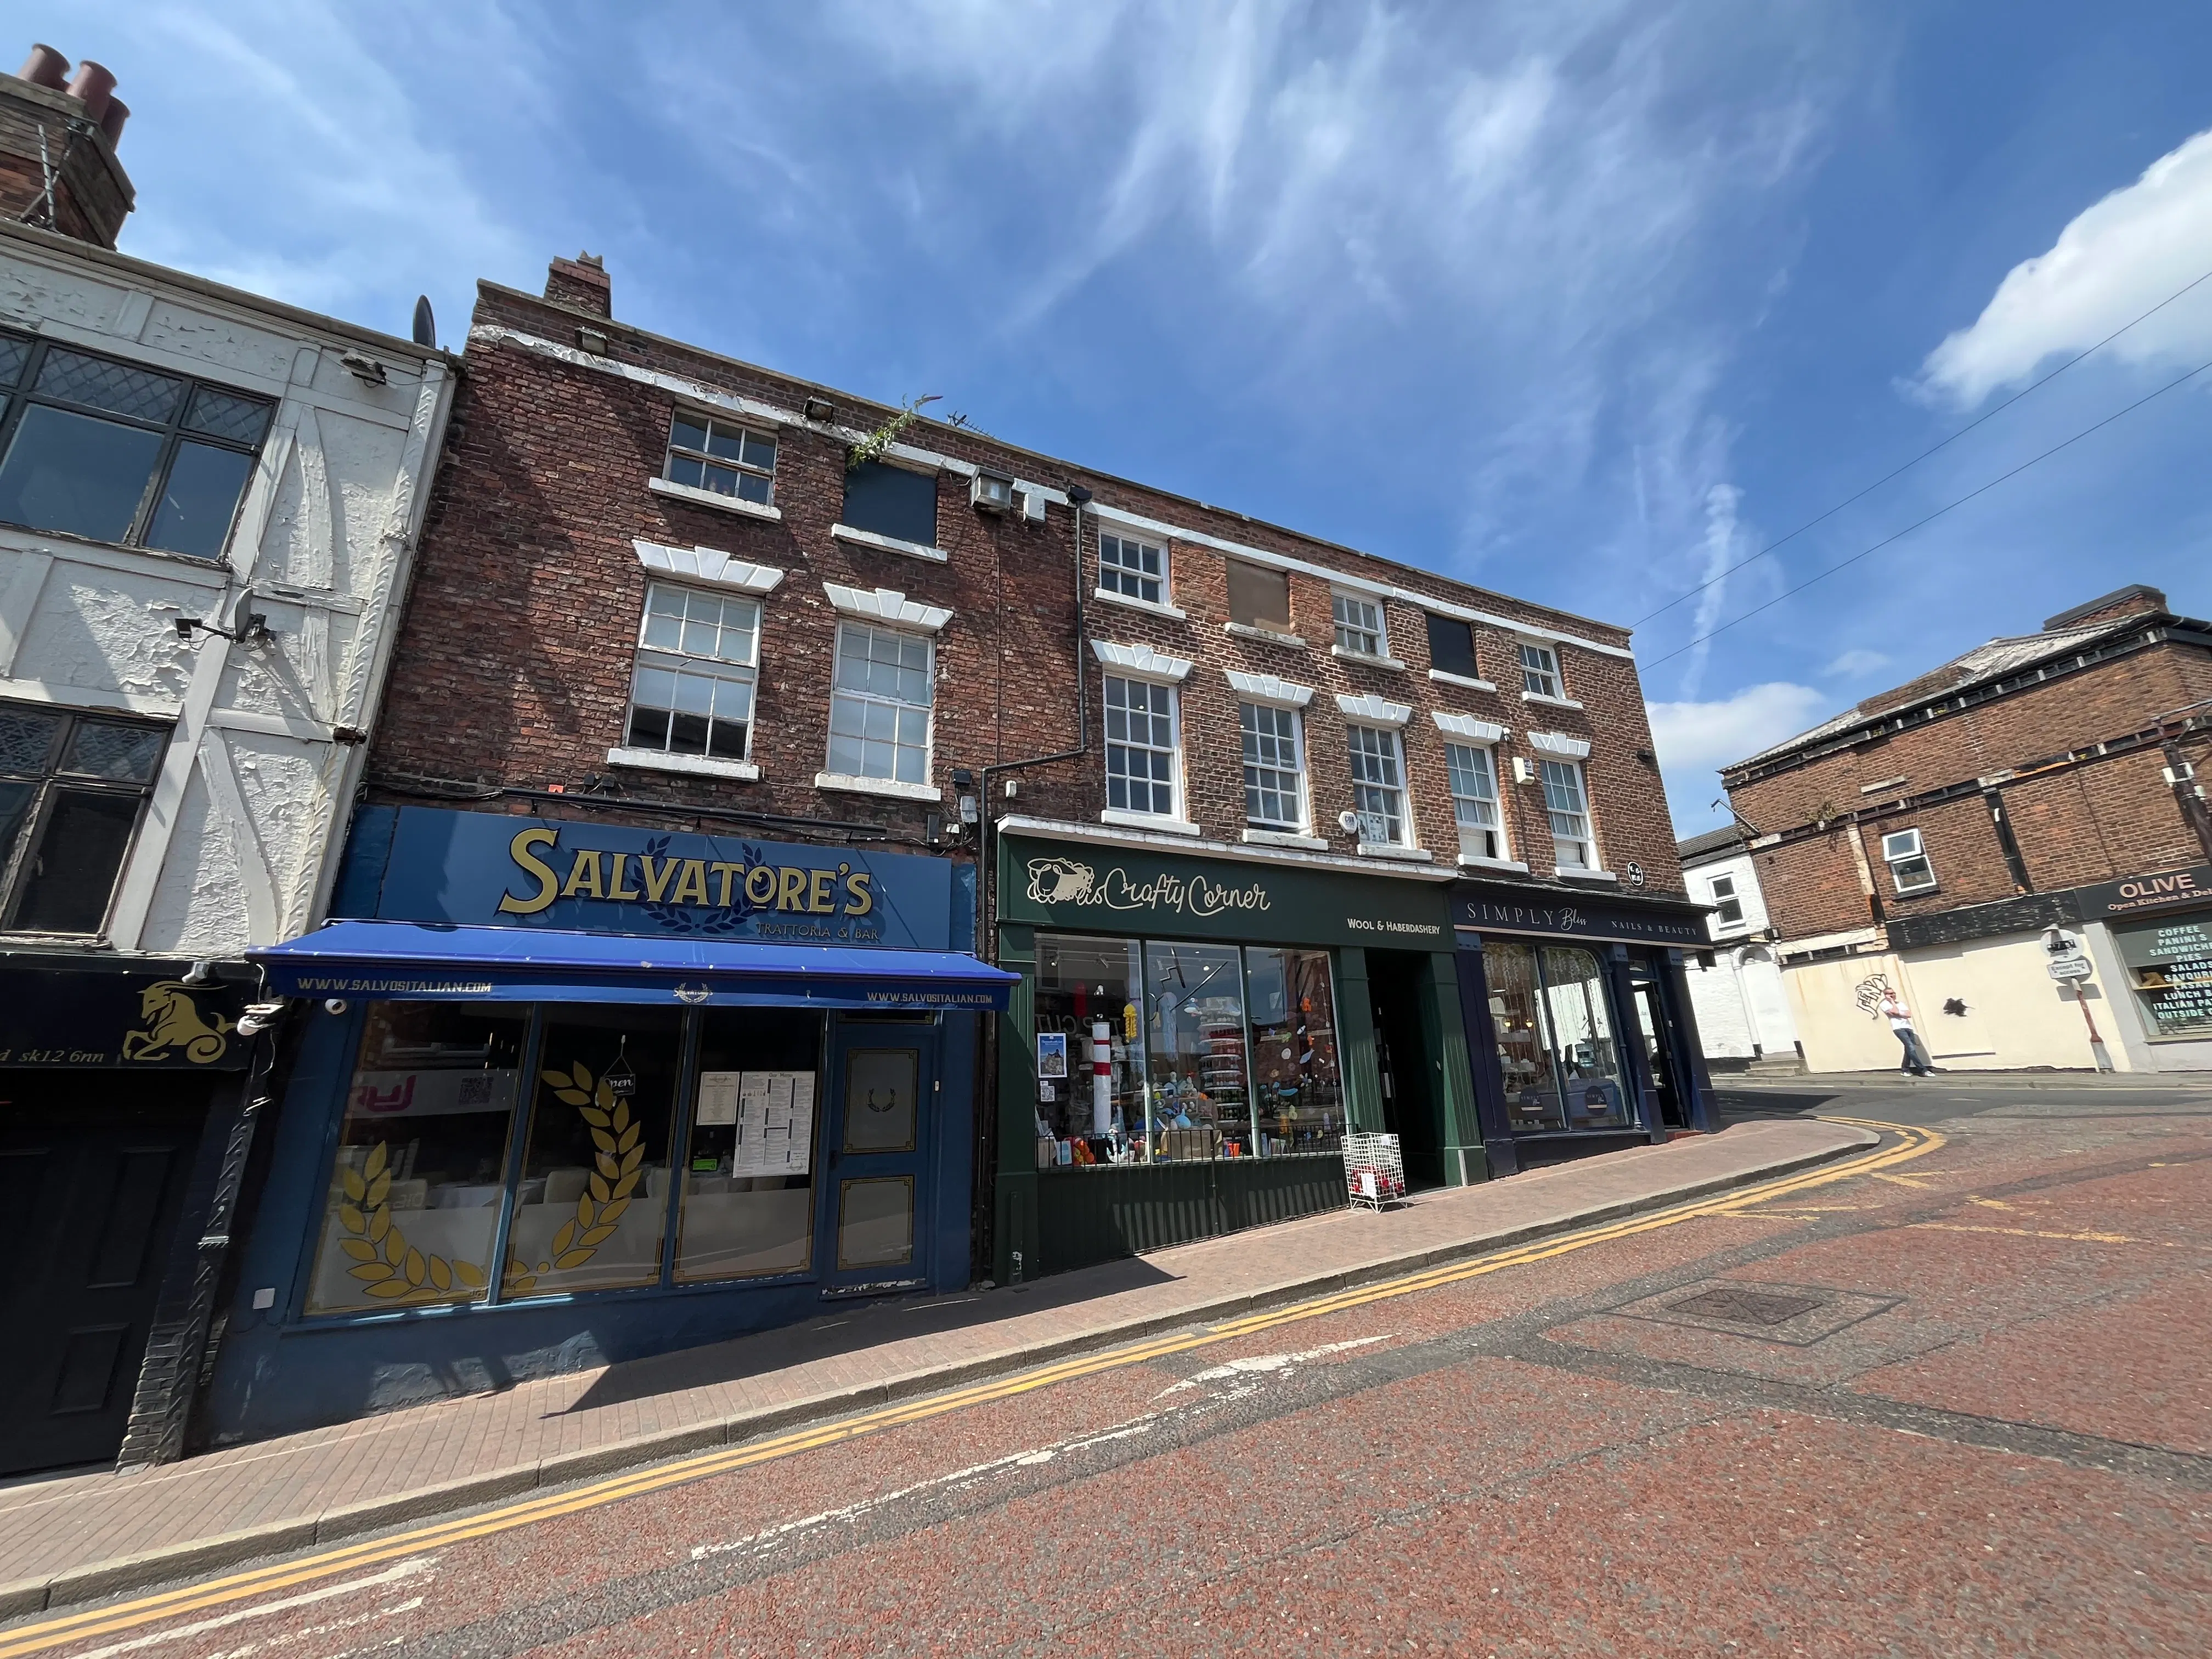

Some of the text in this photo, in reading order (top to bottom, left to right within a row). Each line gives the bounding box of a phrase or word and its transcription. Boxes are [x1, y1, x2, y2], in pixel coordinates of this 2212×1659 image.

[493, 827, 872, 917] SALVATORE'S
[2119, 873, 2196, 898] OLIVE
[1103, 867, 1185, 913] Crafty
[1188, 875, 1271, 916] Corner
[1467, 902, 1588, 931] SIMPLY Bliss
[755, 922, 879, 940] TRATTORIA & BAR
[1376, 921, 1385, 931] &
[1611, 921, 1642, 931] NAILS
[1658, 925, 1697, 936] BEAUTY
[2158, 926, 2200, 937] COFFEE
[2158, 935, 2197, 946] PANINI
[2175, 953, 2202, 962] PIES
[297, 978, 493, 992] WWW.SALVOSITALIAN.COM
[867, 992, 992, 1003] WWW.SALVOSITALIAN.COM
[2163, 990, 2201, 1000] LUNCH
[2153, 1000, 2194, 1010] ITALIAN
[2158, 1008, 2205, 1019] OUTSIDE
